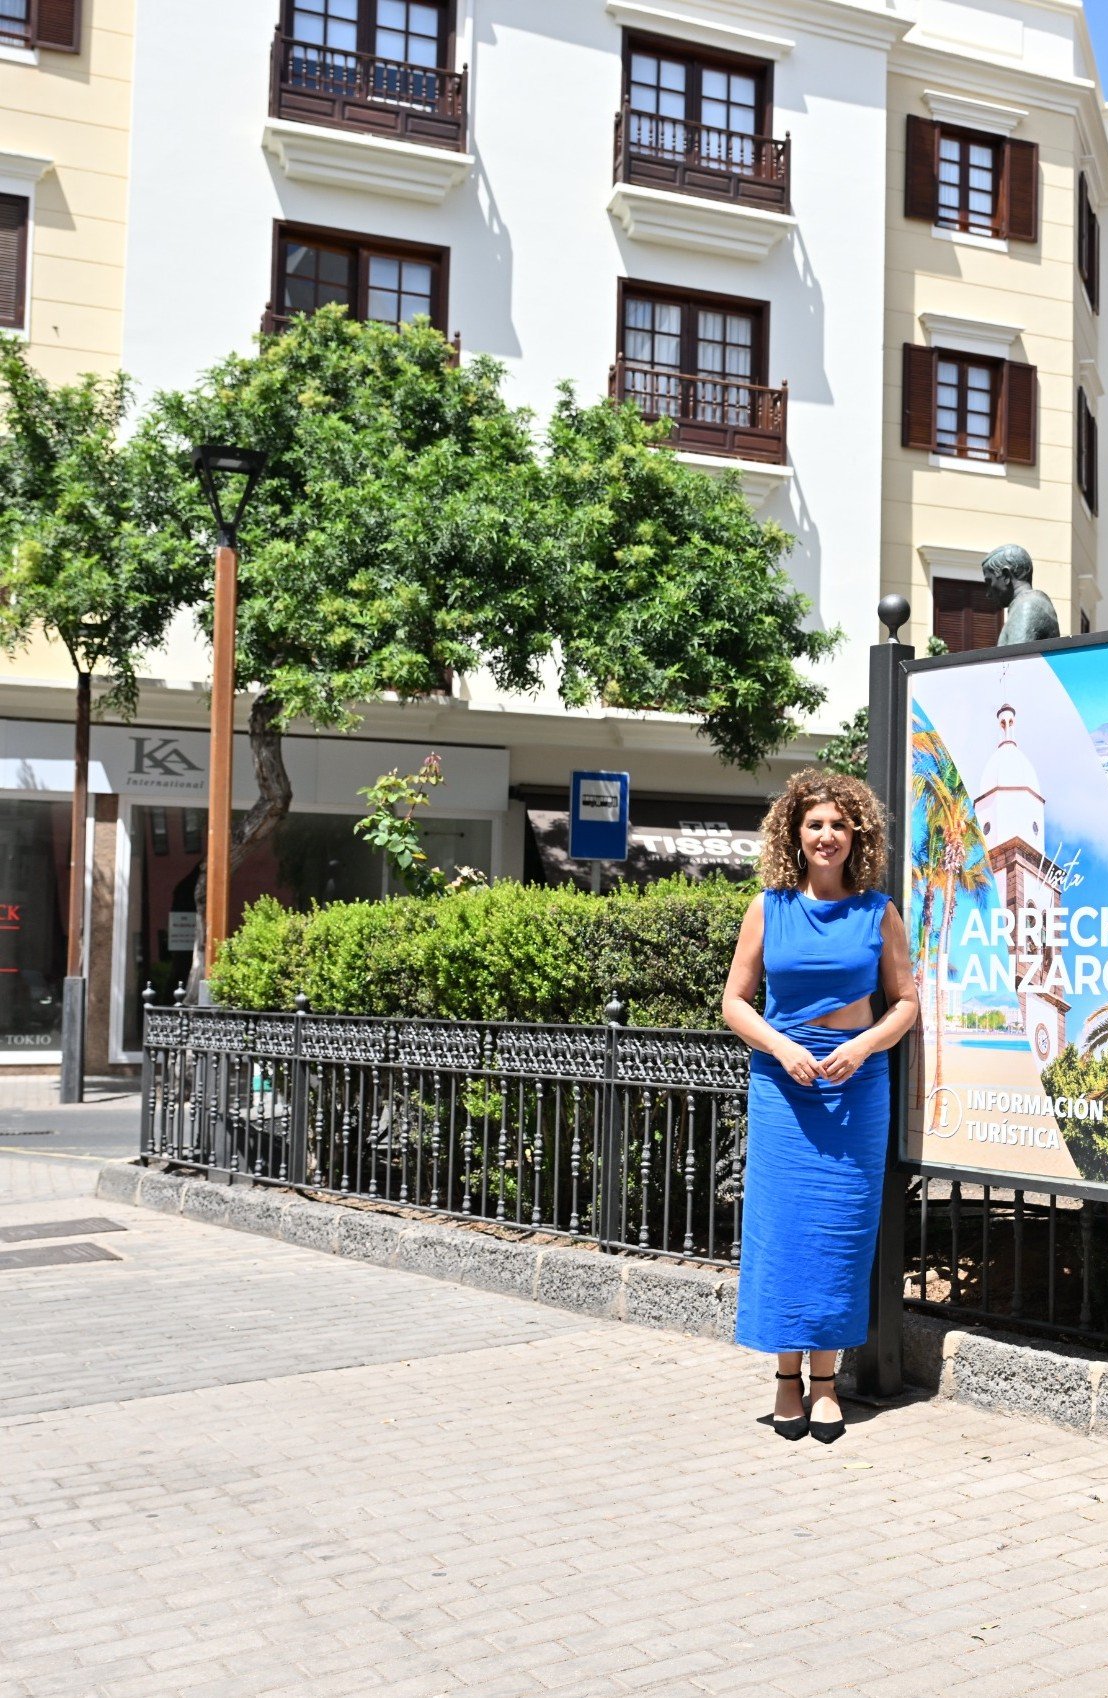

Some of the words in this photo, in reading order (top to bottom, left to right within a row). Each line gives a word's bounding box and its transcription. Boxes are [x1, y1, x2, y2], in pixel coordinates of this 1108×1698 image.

[127, 736, 205, 776] KA
[126, 778, 205, 789] International
[632, 834, 764, 856] TISSO
[1036, 842, 1085, 892] Visita
[5, 1034, 51, 1045] TOKIO
[967, 1089, 1103, 1121] INFORMACIÓN
[966, 1119, 1060, 1150] TURÍSTICA
